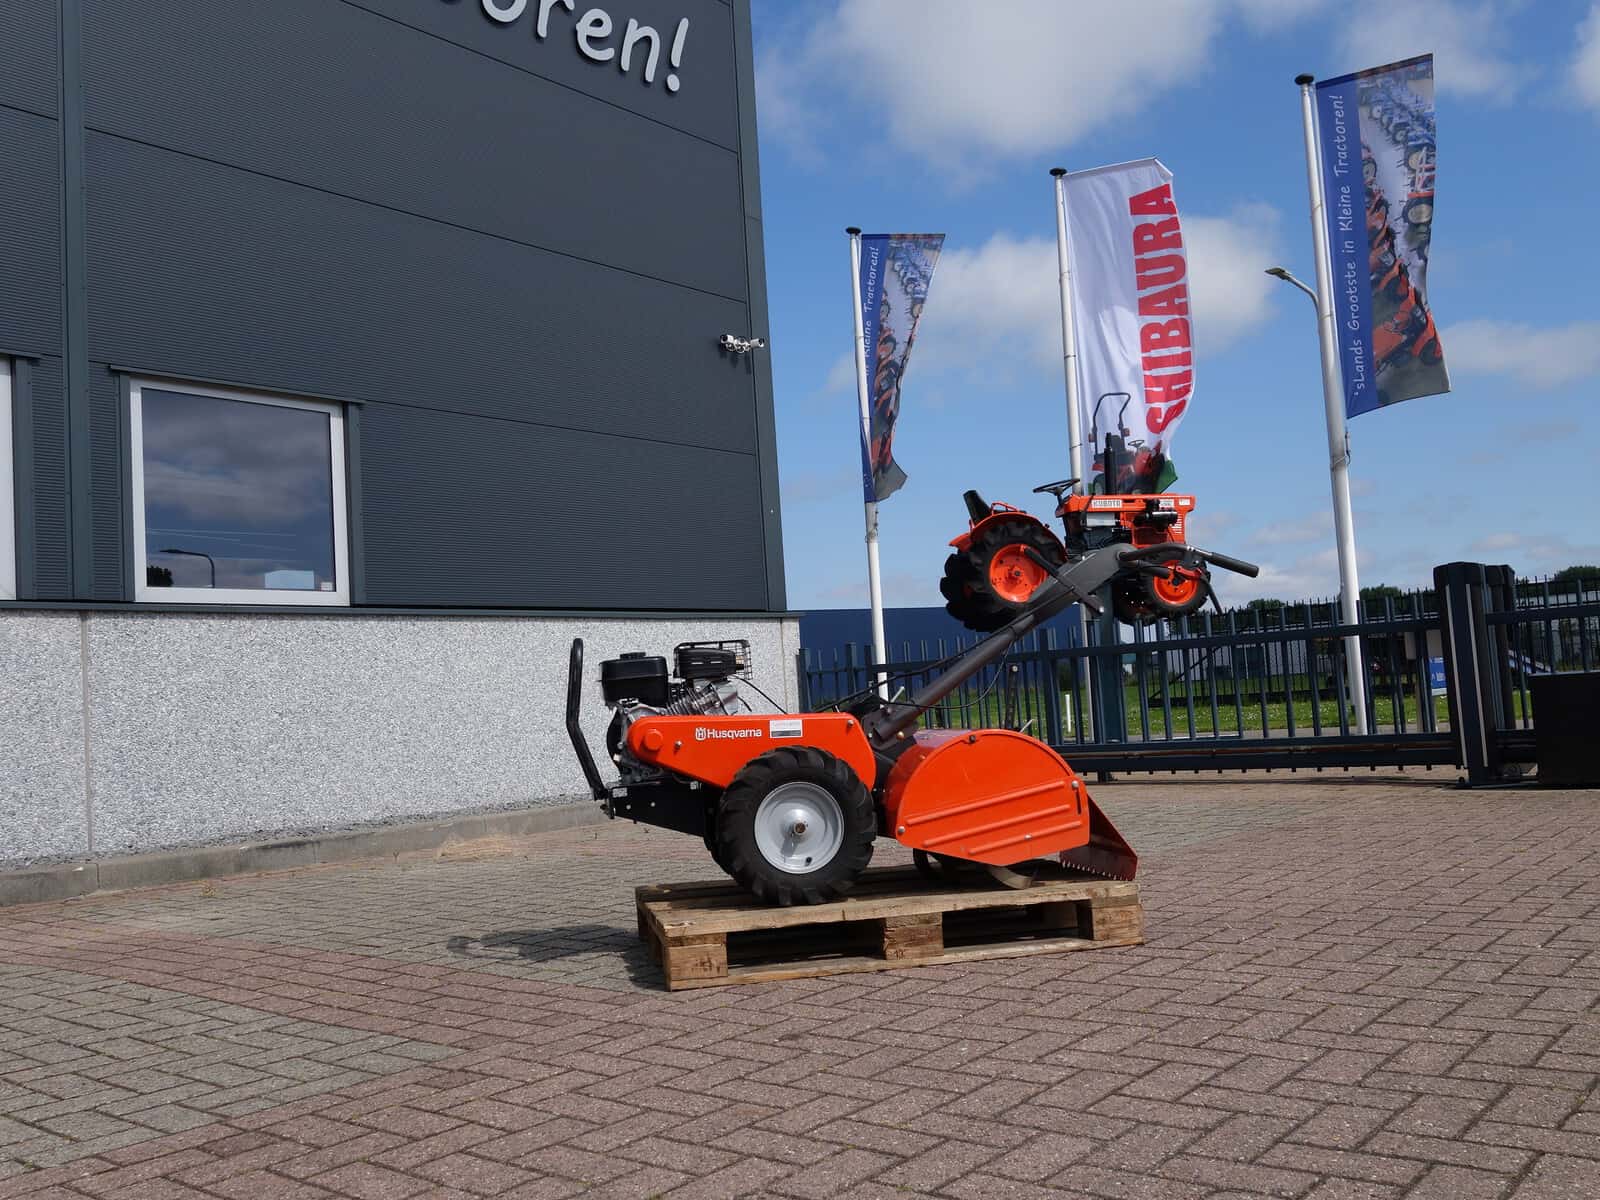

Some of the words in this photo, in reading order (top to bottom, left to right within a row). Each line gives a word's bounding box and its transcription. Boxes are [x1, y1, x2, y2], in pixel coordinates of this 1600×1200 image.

[1329, 95, 1349, 177] Tractoren!
[1336, 185, 1353, 232] Kleine
[863, 246, 879, 313] Tractoren!
[1342, 240, 1355, 253] in
[1129, 183, 1192, 434] SHIBAURA
[1345, 262, 1360, 331] Grootste
[706, 728, 763, 739] Husqvarna
